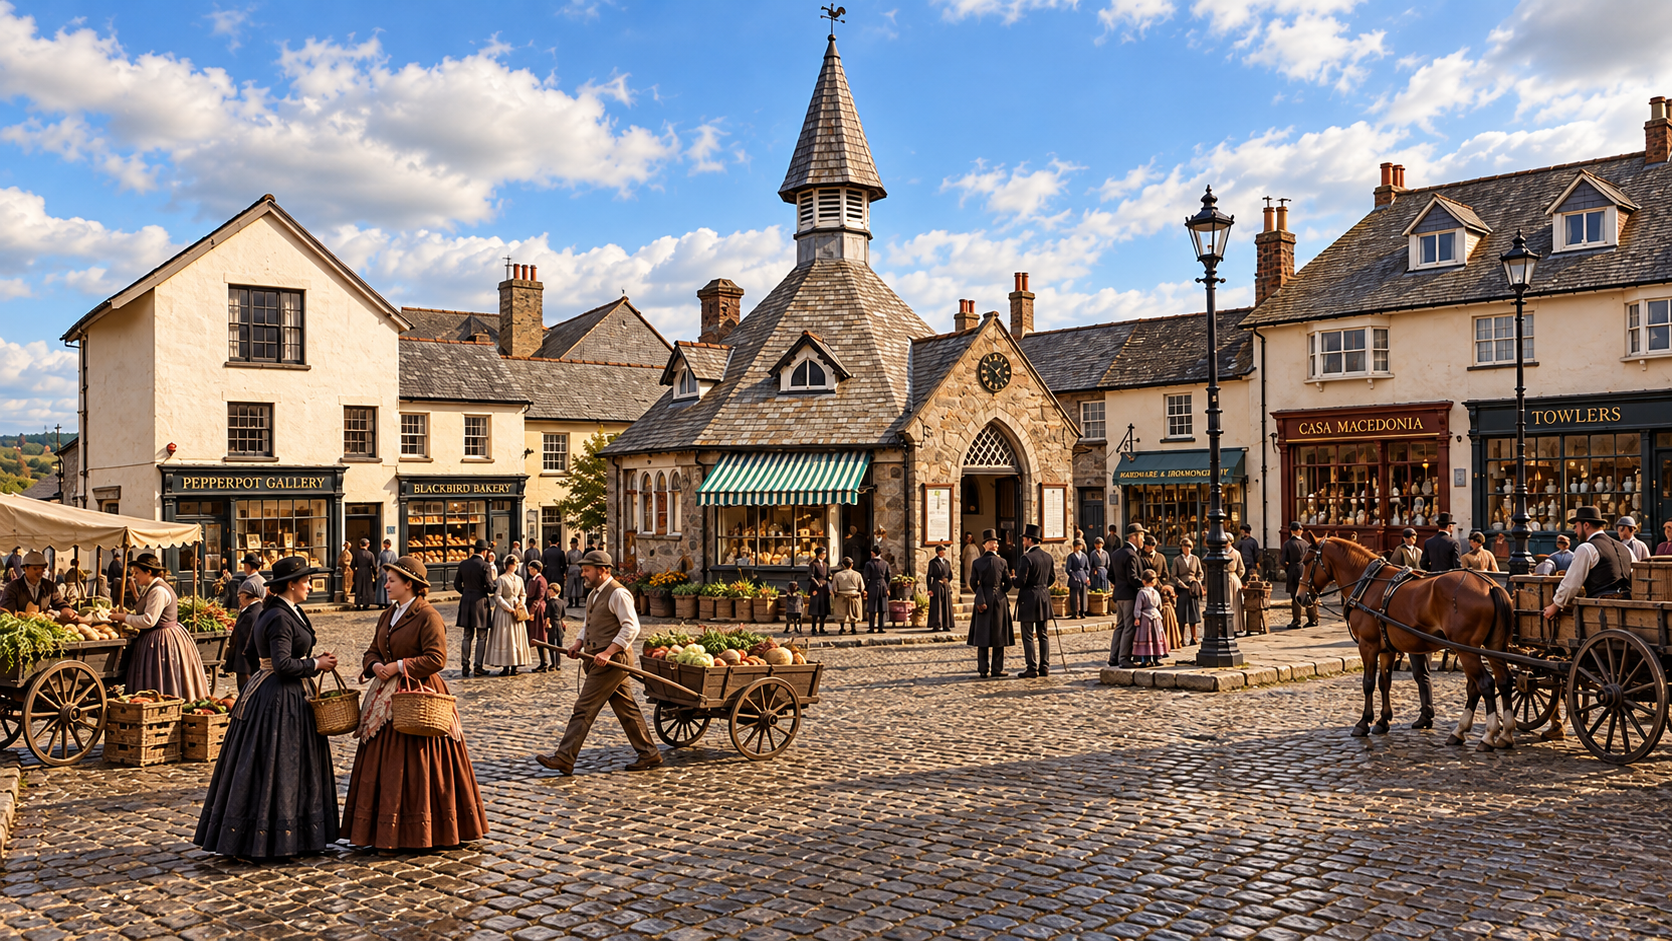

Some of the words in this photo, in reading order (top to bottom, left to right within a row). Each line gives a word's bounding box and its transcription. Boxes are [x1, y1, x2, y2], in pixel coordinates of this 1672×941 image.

[1531, 406, 1621, 425] TOWLERS
[1299, 421, 1332, 435] CASA
[1337, 417, 1424, 433] MACEDONIA
[182, 477, 262, 489] PEPPERPOT
[265, 477, 325, 489] GALLERY
[414, 484, 470, 493] BLACKBIRD
[473, 484, 511, 493] BAKERY
